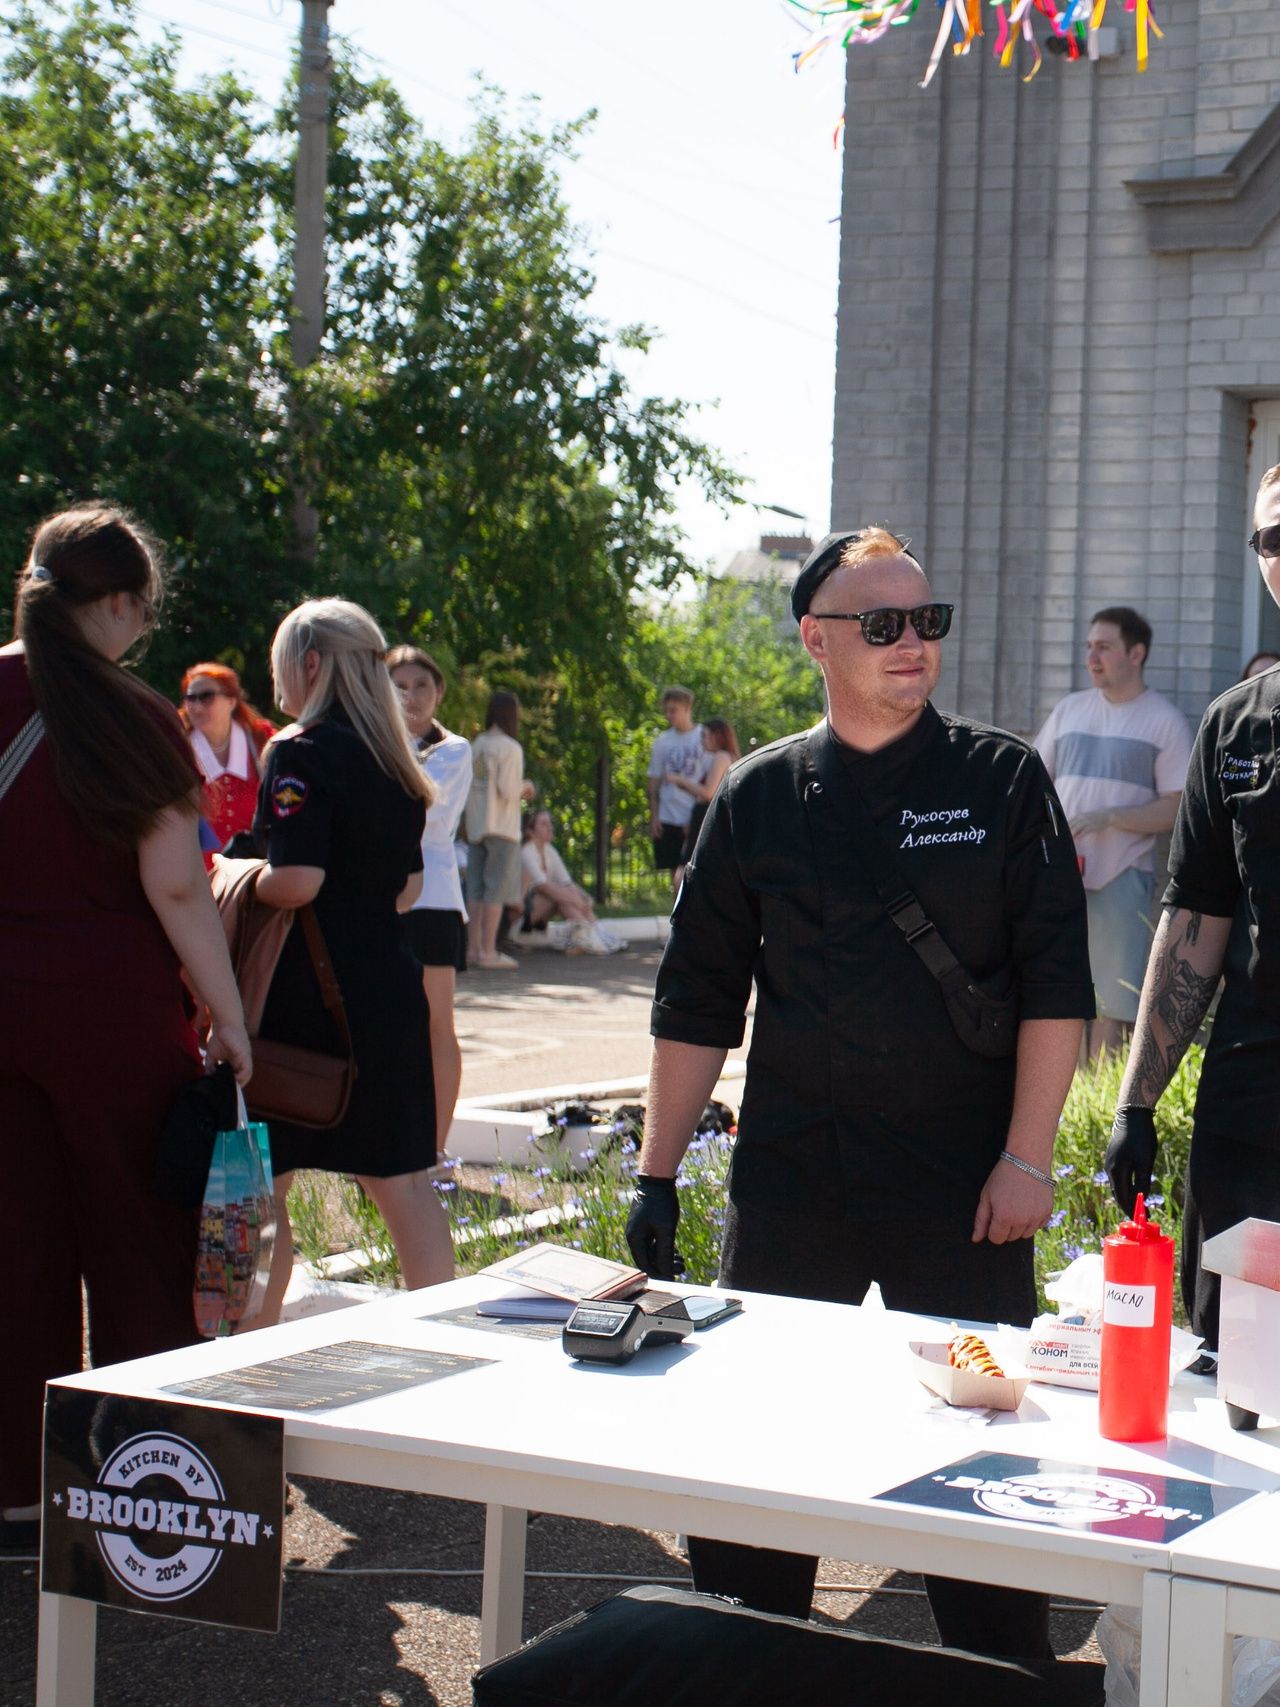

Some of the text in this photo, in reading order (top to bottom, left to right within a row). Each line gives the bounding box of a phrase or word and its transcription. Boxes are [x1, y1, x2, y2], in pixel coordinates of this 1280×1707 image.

[899, 808, 970, 829] Рукосуев
[899, 825, 987, 849] Александр
[1030, 1346, 1068, 1358] КОНОМ
[118, 1450, 205, 1487] KITCHEN BY
[66, 1486, 260, 1546] BROOKLYN
[124, 1554, 189, 1582] EST 2024
